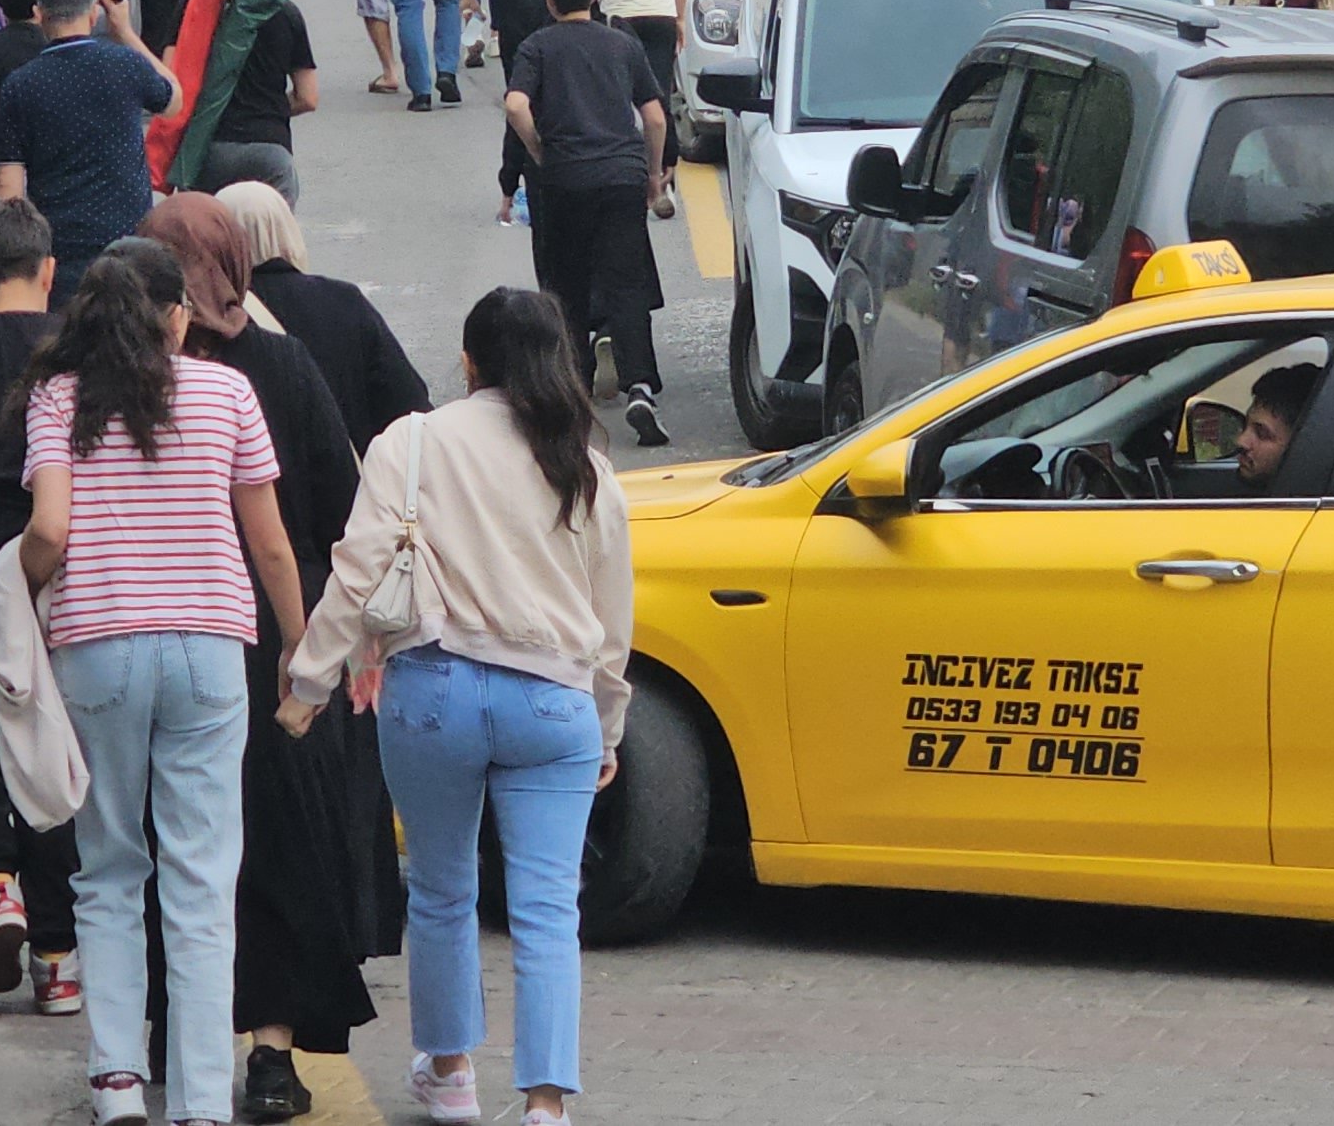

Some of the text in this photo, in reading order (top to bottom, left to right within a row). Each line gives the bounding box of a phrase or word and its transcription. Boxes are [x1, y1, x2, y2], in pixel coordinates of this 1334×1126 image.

[901, 653, 1144, 695] INCIVEZ TAKSI
[906, 696, 1140, 731] 0533 193 04 06
[907, 732, 1142, 778] 67 T 0406
